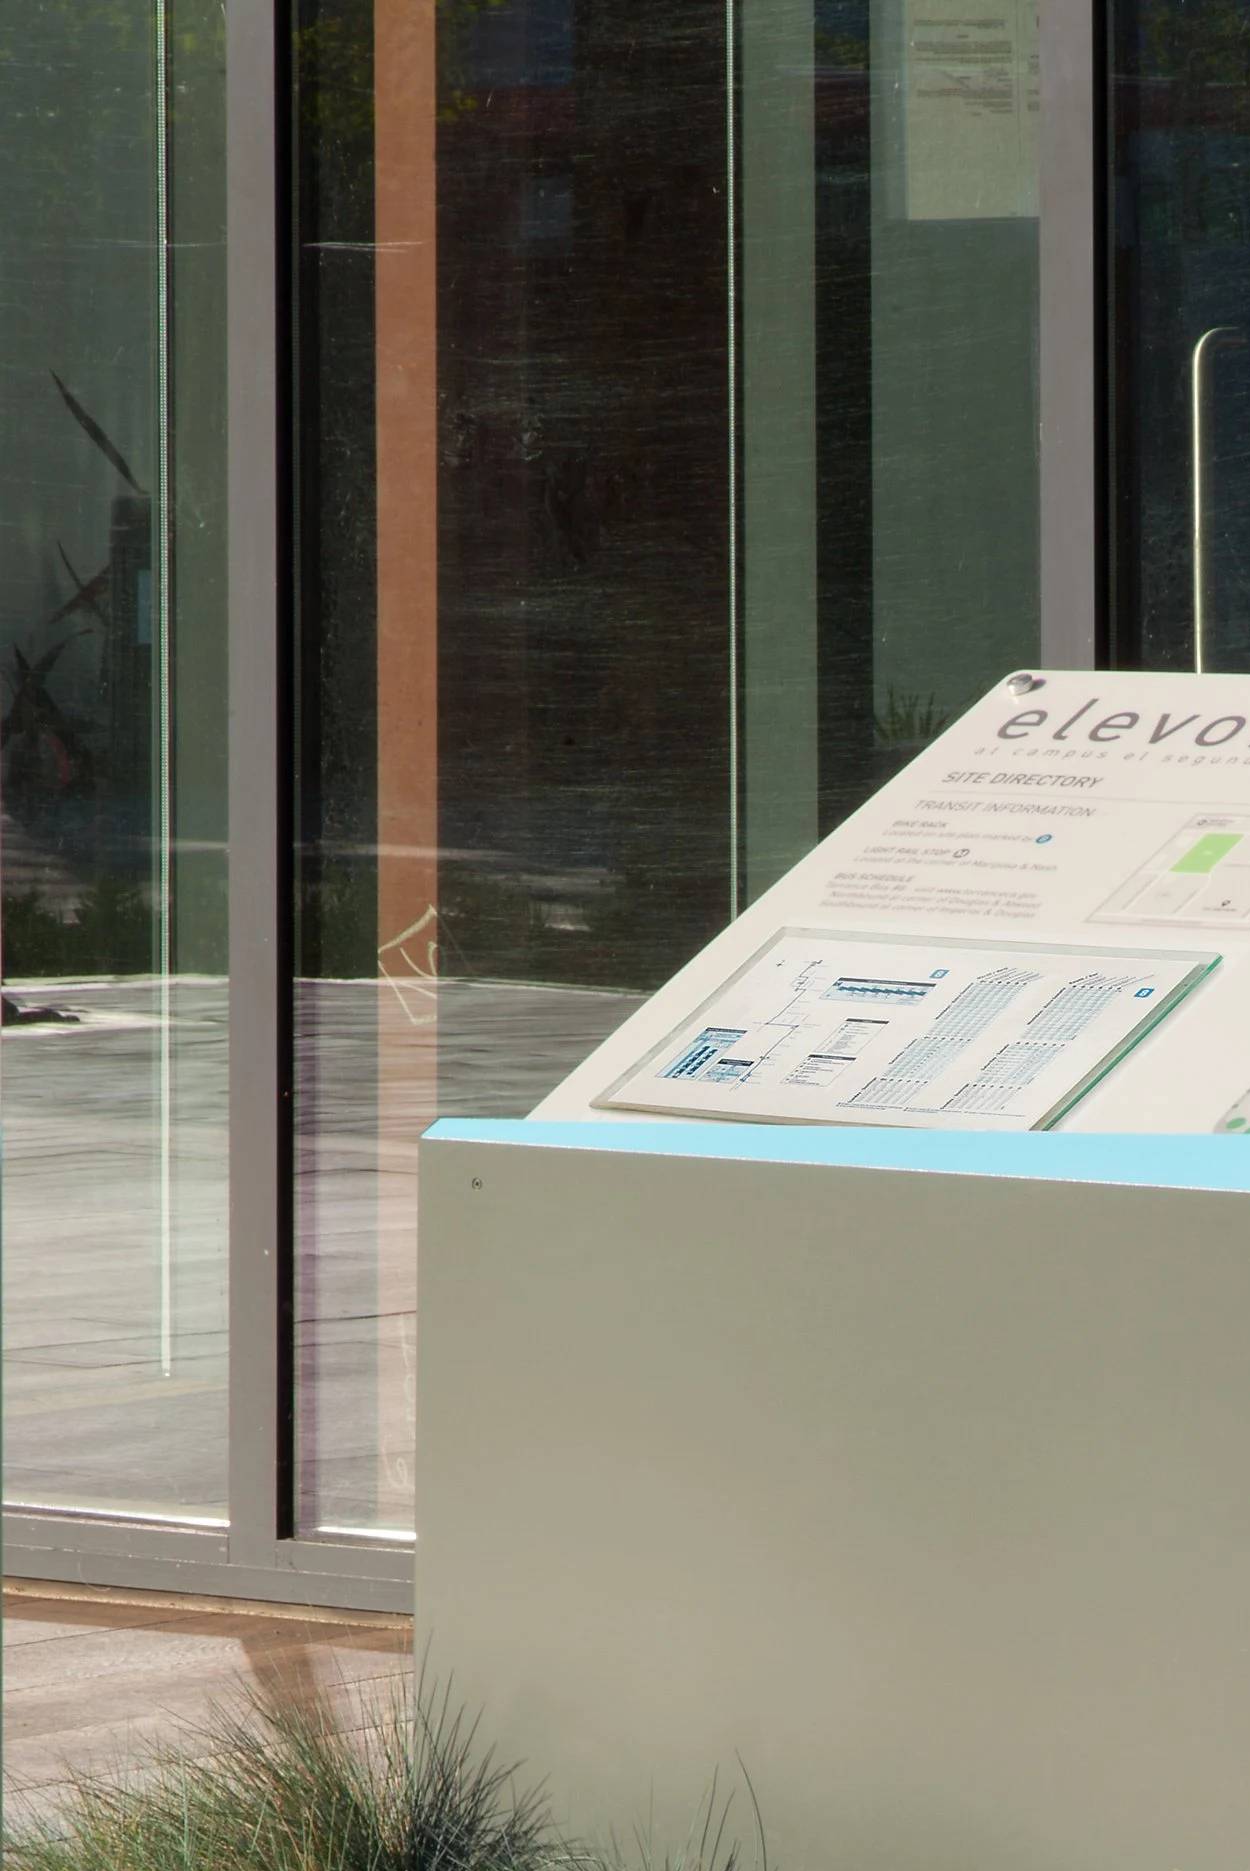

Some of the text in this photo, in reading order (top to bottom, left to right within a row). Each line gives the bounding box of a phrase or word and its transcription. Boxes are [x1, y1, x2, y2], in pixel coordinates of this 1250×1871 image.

[974, 746, 999, 755] at
[1012, 748, 1108, 760] campus
[1123, 752, 1149, 761] el
[941, 772, 1104, 788] SITE DIRECTORY
[913, 799, 1096, 817] TRANSIT INFORMATION
[892, 819, 950, 828] BIKE RACK
[882, 829, 923, 837] Located
[863, 846, 898, 854] LIGHT
[895, 847, 919, 856] RAIL
[921, 848, 951, 856] STOP
[852, 855, 892, 864] Located
[834, 872, 916, 883] BUS SCHEDULE
